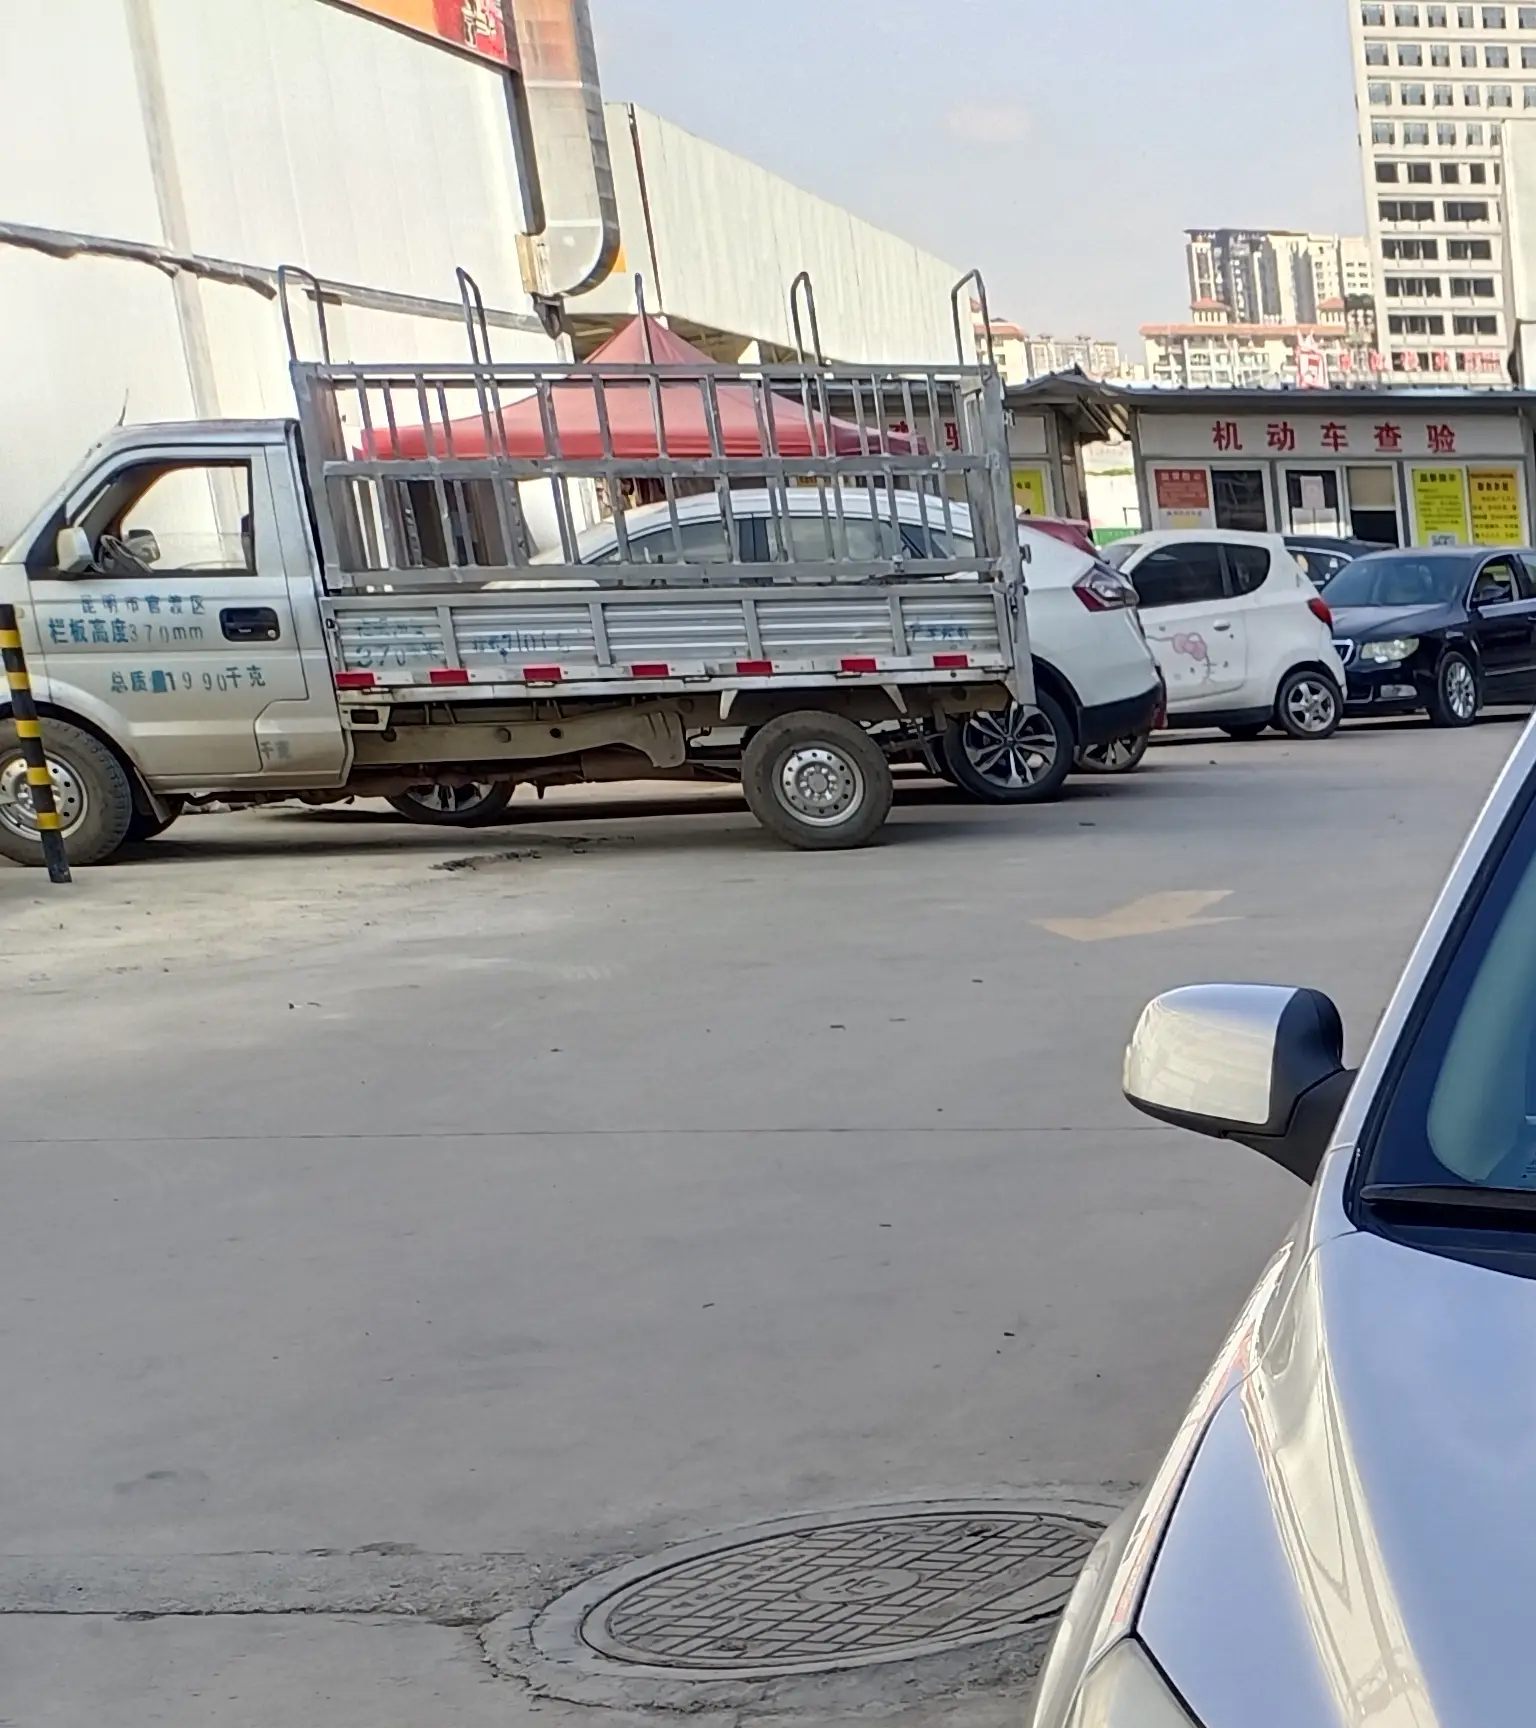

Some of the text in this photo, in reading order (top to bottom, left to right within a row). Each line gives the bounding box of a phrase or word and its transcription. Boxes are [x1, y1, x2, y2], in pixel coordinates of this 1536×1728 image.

[1212, 421, 1456, 453] 机动车查验
[81, 594, 205, 615] 昆明市官渡区
[49, 618, 203, 644] 栏板高度370mm
